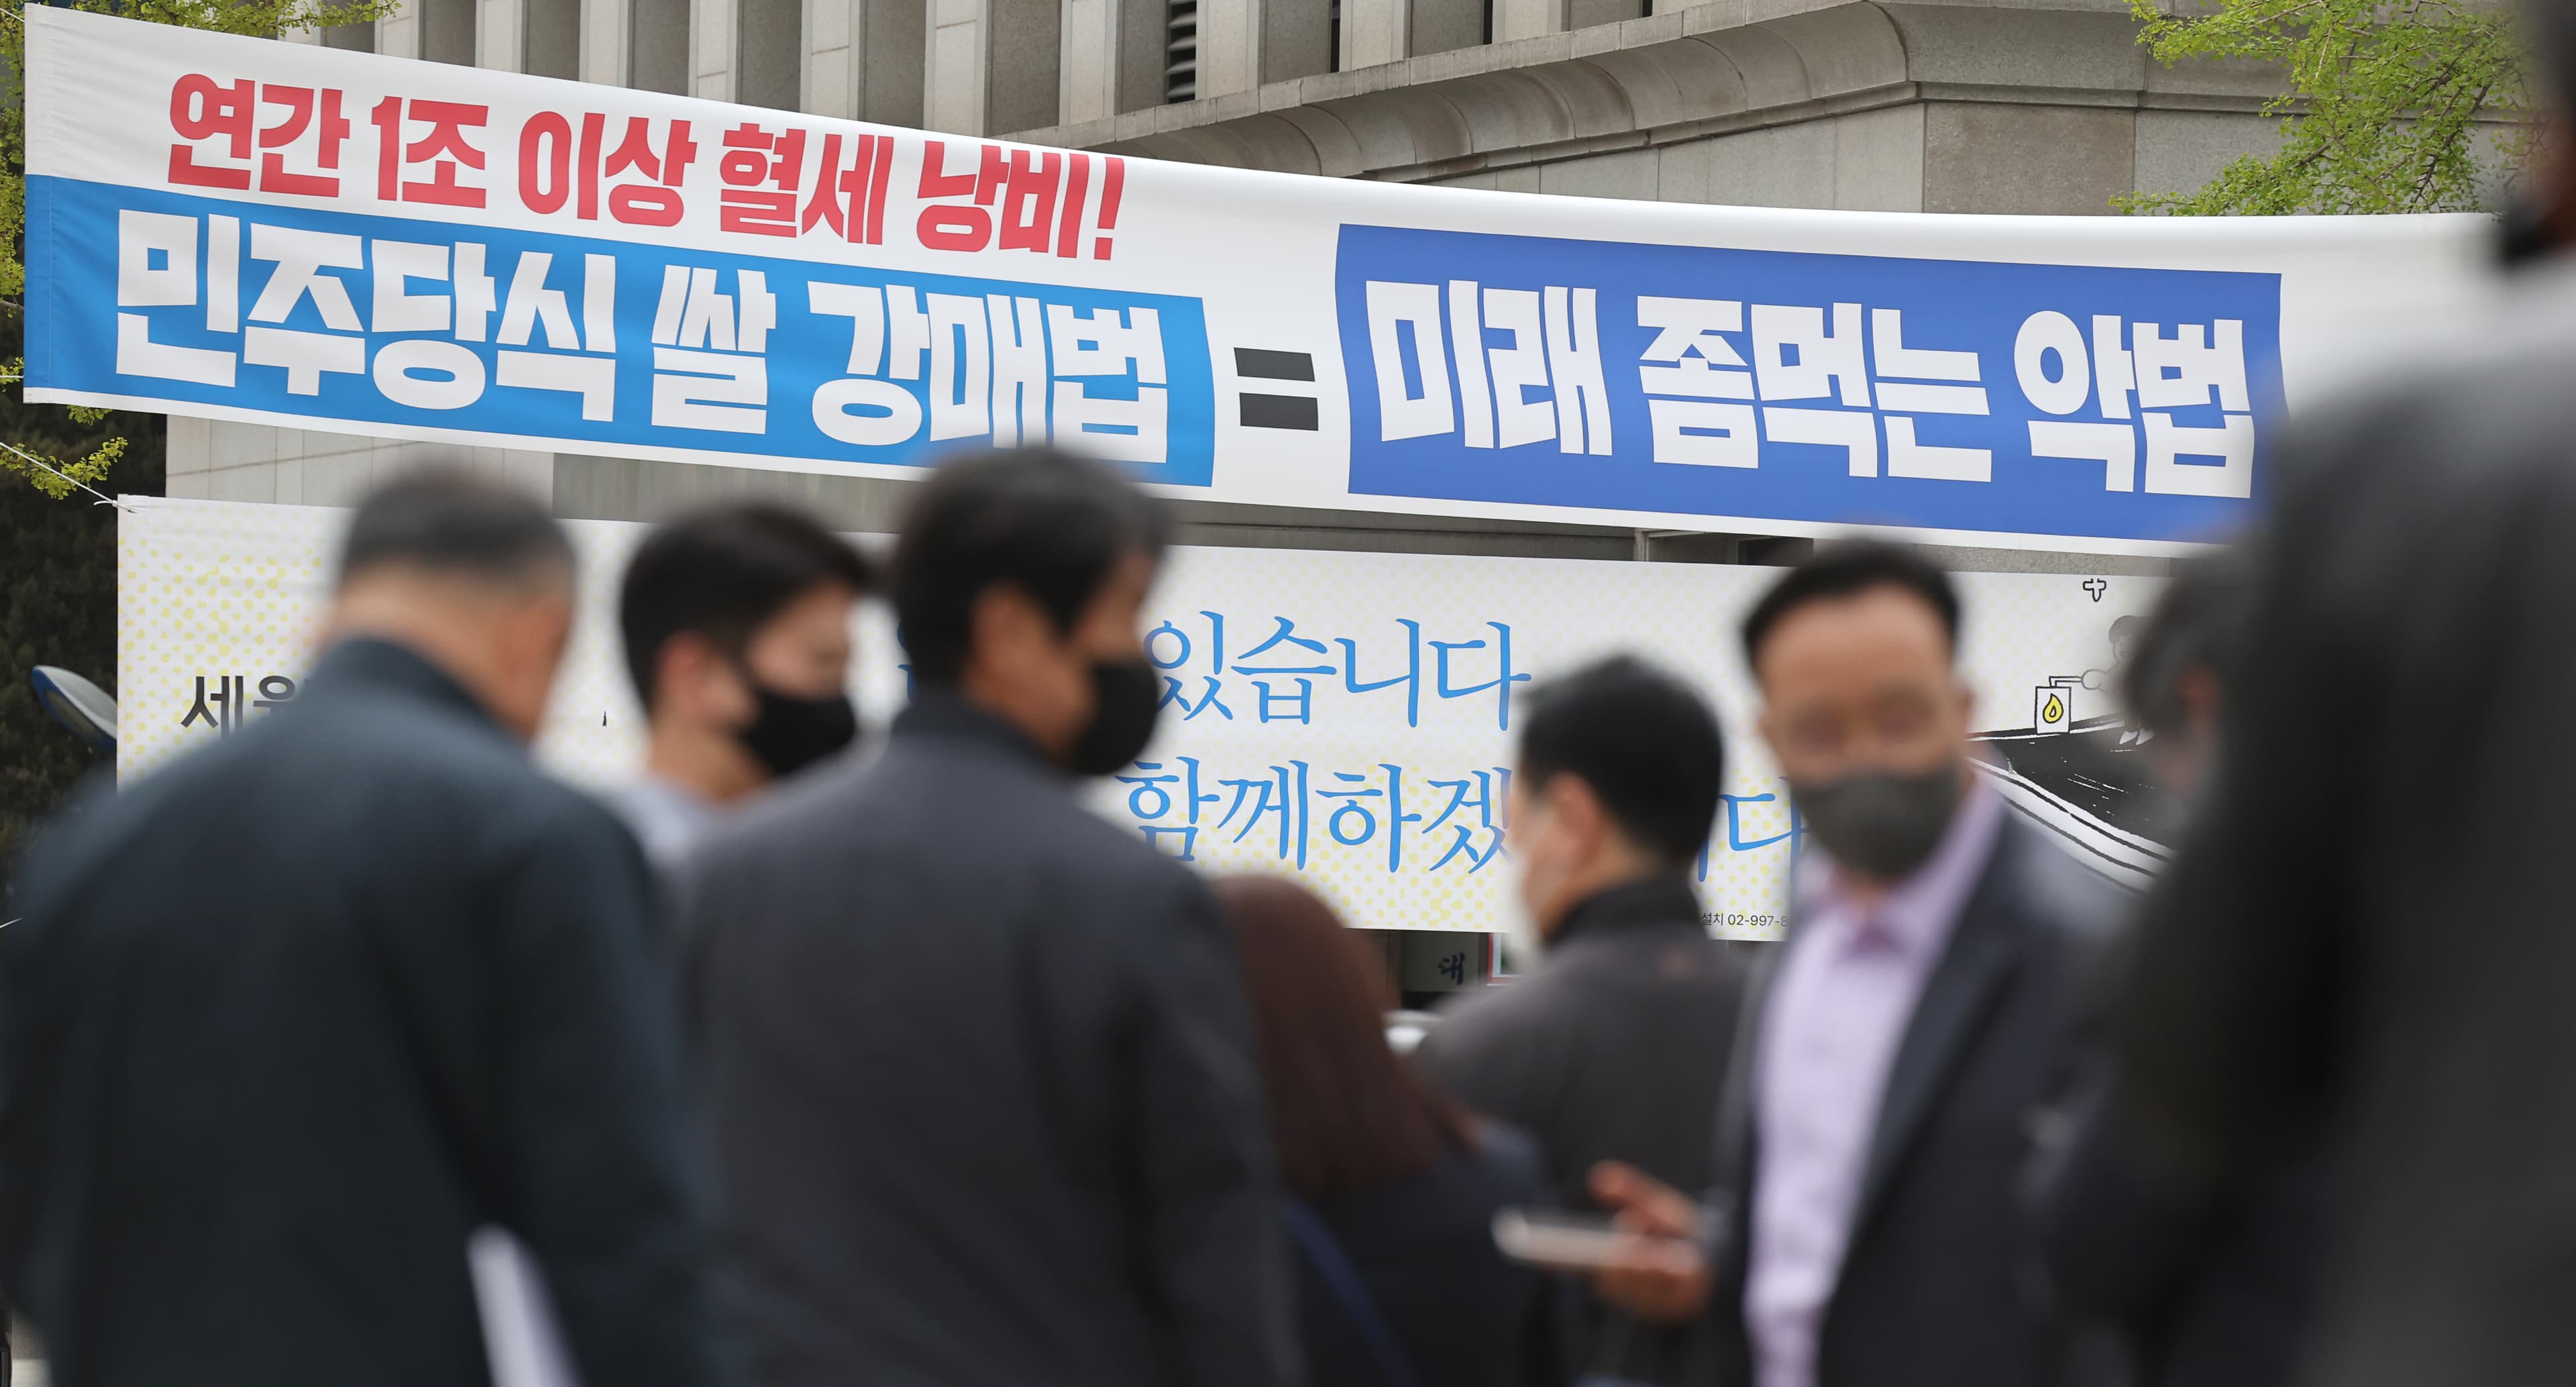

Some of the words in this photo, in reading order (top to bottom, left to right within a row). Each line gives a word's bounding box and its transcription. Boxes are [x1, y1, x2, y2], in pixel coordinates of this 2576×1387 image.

[168, 73, 350, 198] 연간
[371, 95, 489, 209] 1조
[518, 111, 698, 227] 이상
[720, 122, 894, 246] 혈세
[916, 140, 1125, 261] 낭비!
[115, 209, 616, 423] 민주당식
[651, 264, 776, 435] 쌀
[807, 279, 1169, 464] 강매법
[1365, 279, 1613, 456] 미래
[1637, 295, 1993, 483] 좀먹는
[2013, 310, 2255, 499] 악법
[1144, 611, 1532, 731] 있습니다
